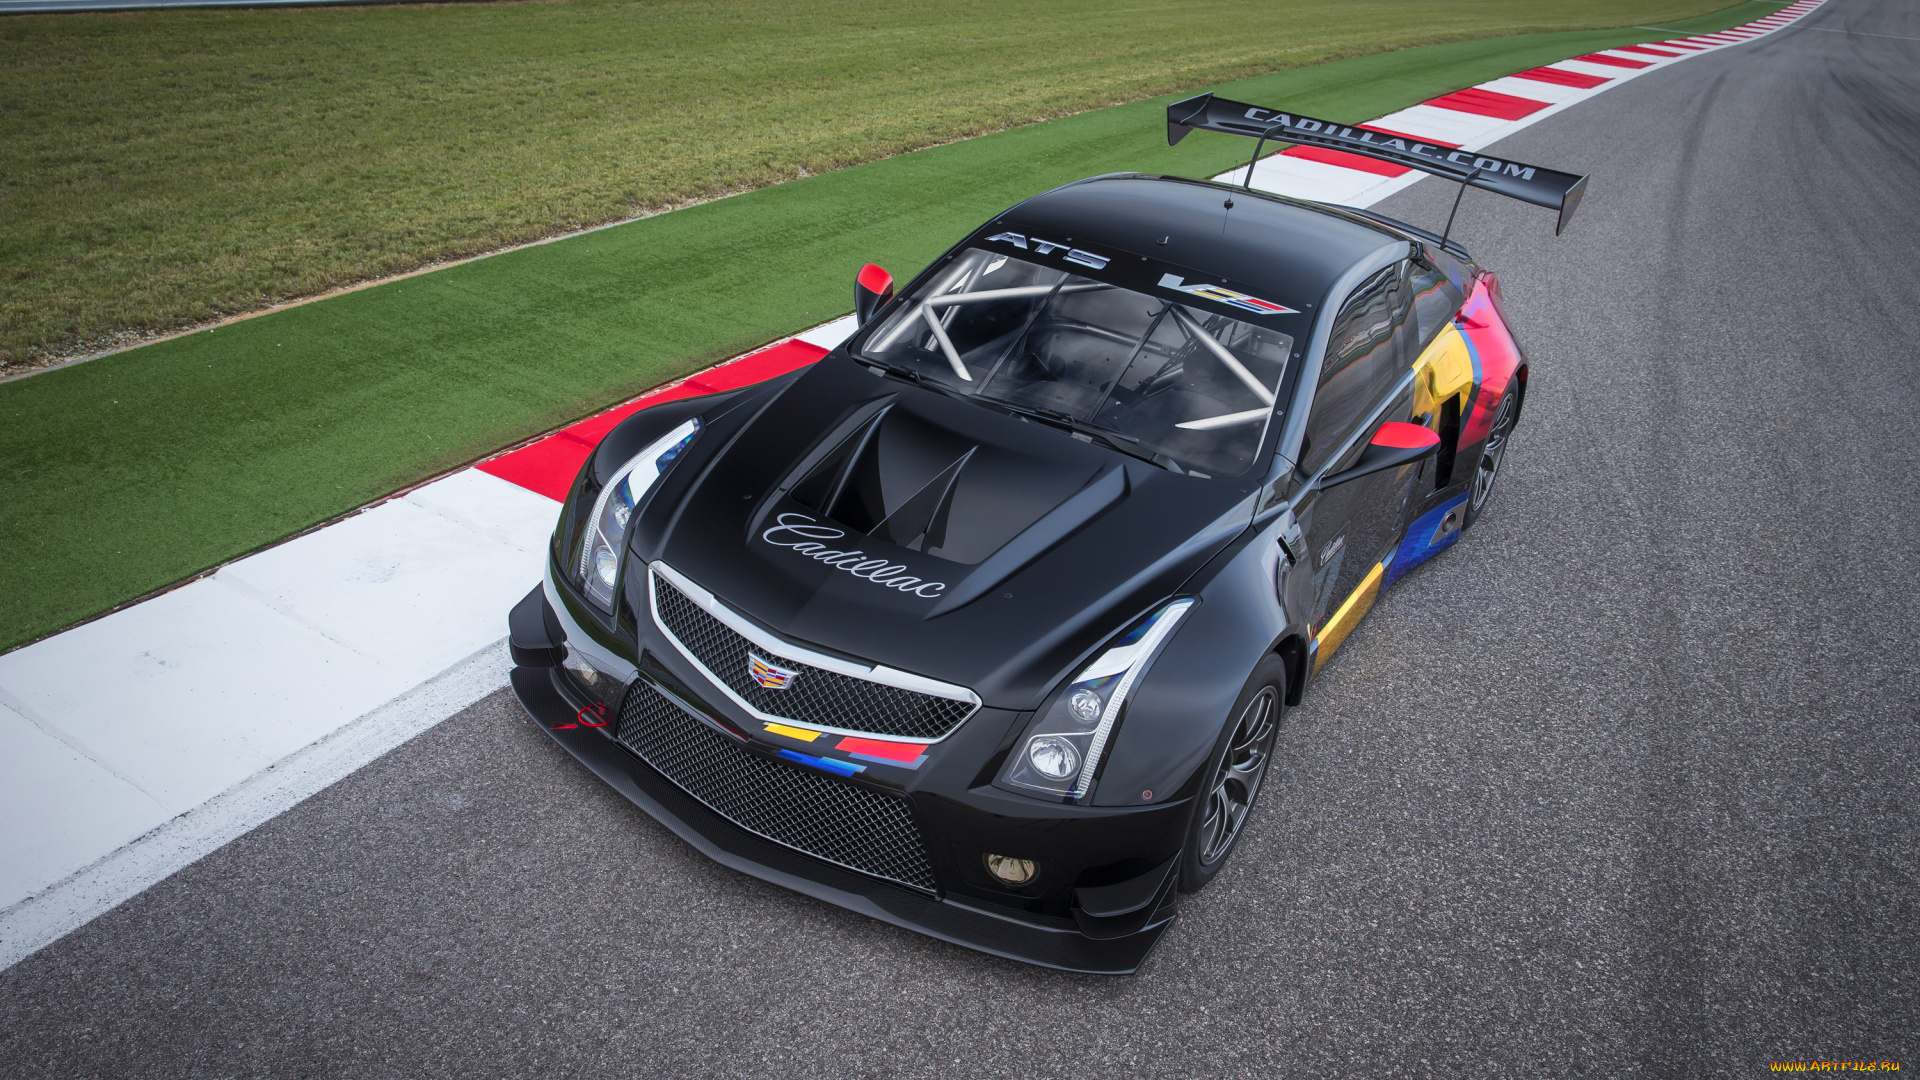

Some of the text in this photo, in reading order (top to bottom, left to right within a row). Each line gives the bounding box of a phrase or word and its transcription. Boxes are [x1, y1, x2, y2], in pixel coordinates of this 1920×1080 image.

[1244, 107, 1536, 181] CADILLAC.COM
[984, 231, 1111, 270] ATS
[762, 512, 946, 598] Cadillac
